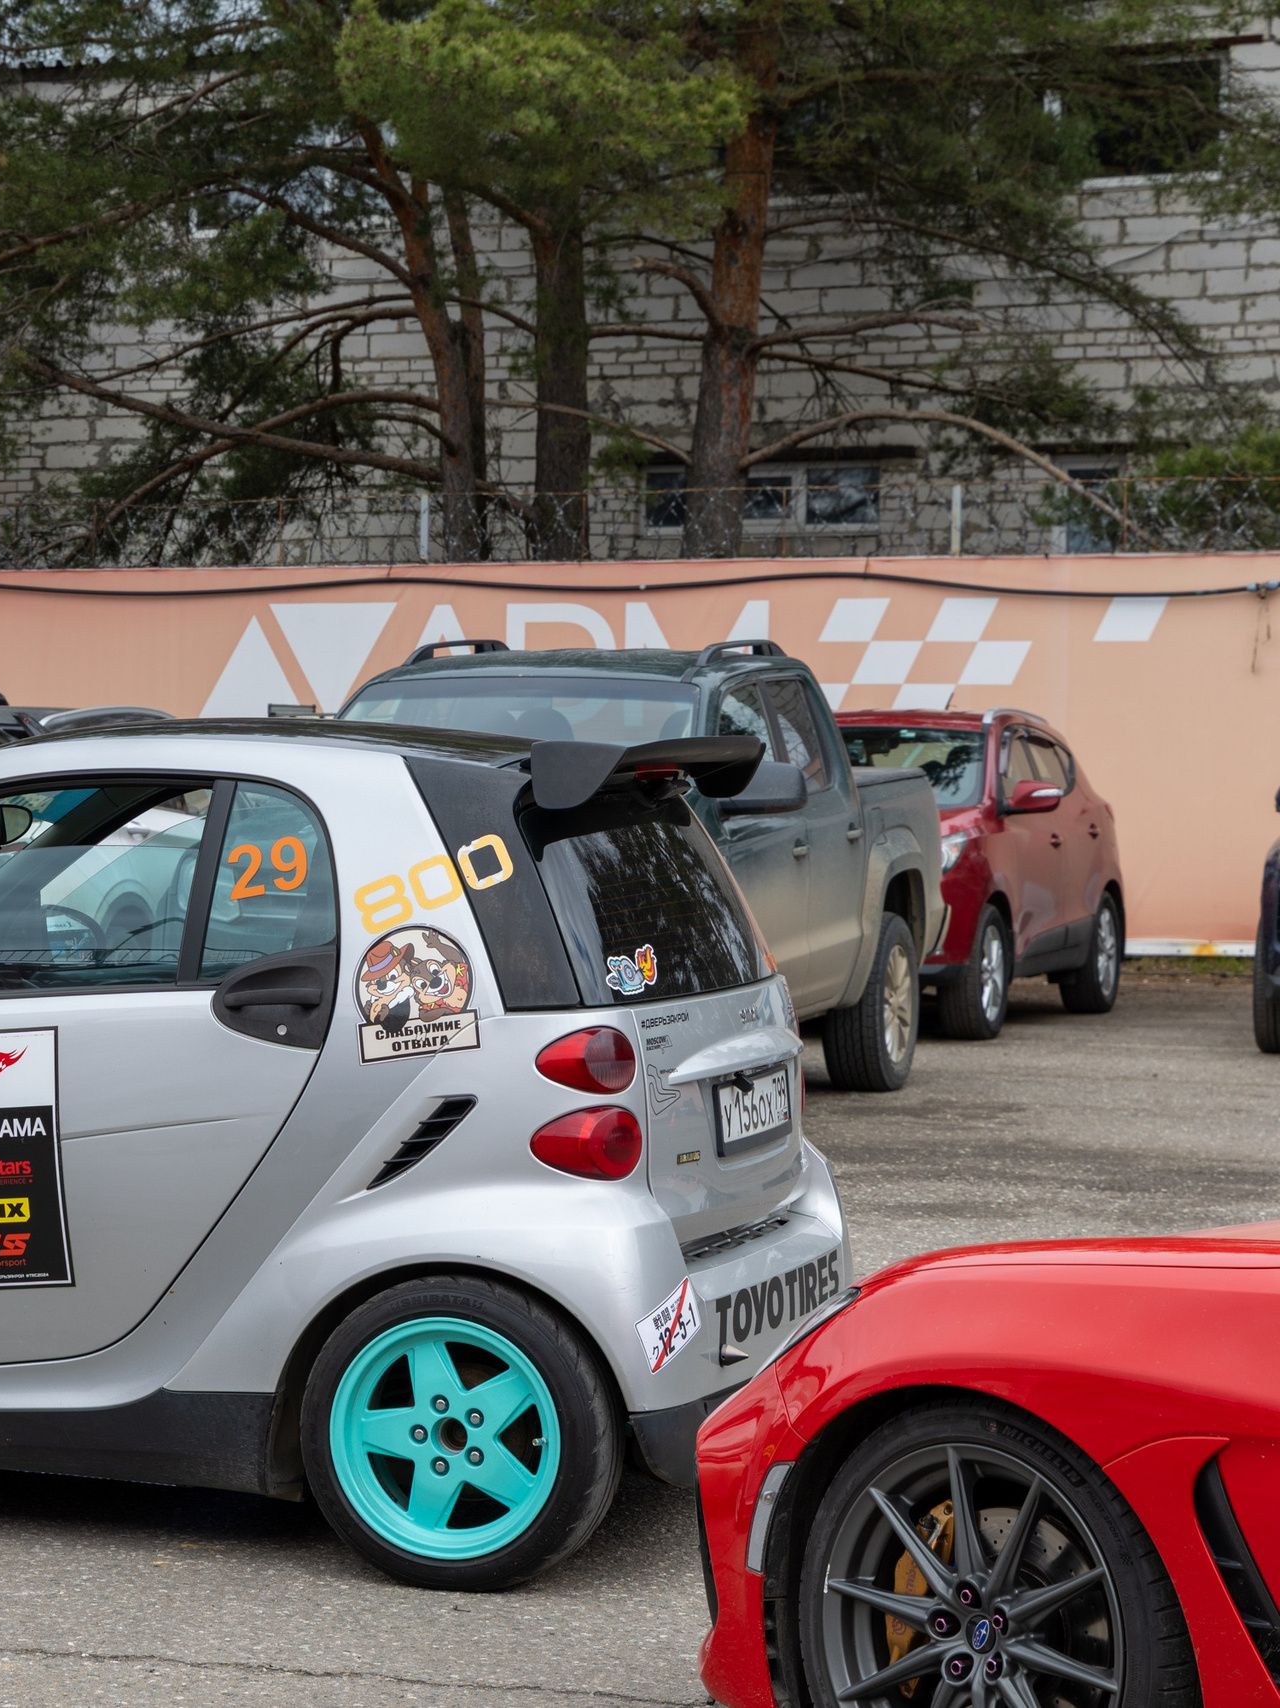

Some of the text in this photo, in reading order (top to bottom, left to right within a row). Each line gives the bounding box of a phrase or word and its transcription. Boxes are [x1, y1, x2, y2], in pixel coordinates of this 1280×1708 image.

[227, 836, 308, 901] 29
[353, 833, 514, 934] 800
[375, 1019, 461, 1041] СЛАБОУМИЕ
[392, 1035, 449, 1052] ОТВАГА
[641, 1010, 689, 1030] #ДВЕРЬЗАКРОЙ
[773, 1075, 786, 1110] 799
[716, 1249, 840, 1345] TOYO TIRES
[658, 1302, 697, 1357] 12-5-1
[1002, 1425, 1083, 1486] MICHELIN
[1087, 1489, 1106, 1514] PILOT
[1104, 1514, 1122, 1544] SPORT
